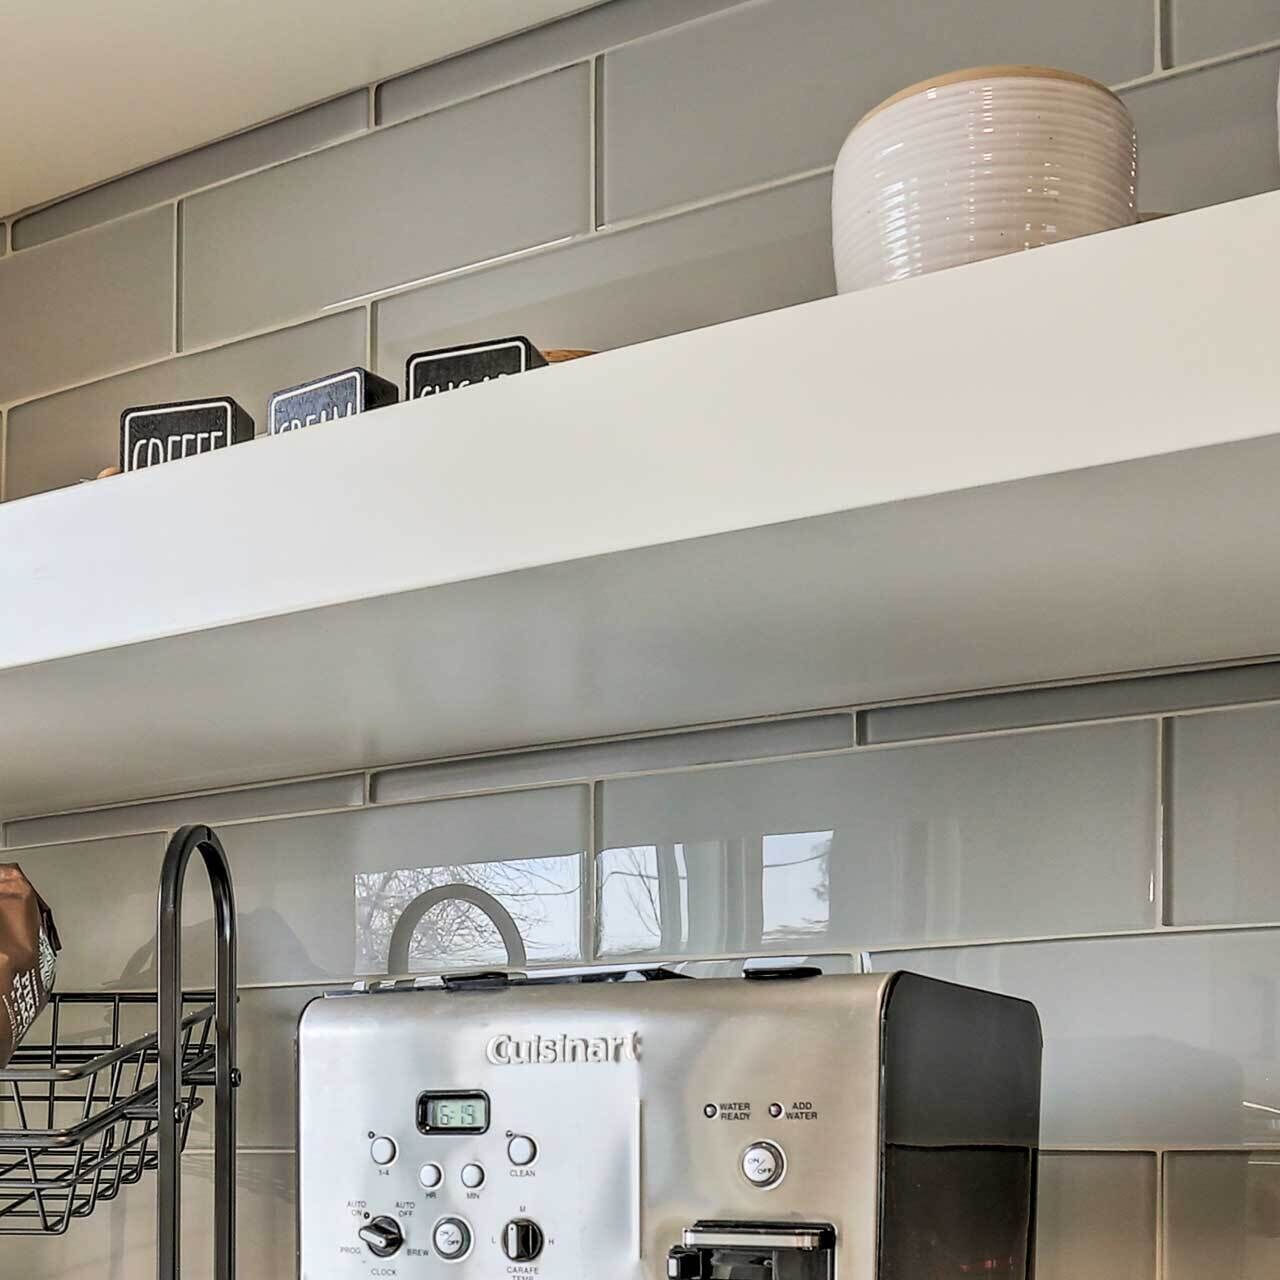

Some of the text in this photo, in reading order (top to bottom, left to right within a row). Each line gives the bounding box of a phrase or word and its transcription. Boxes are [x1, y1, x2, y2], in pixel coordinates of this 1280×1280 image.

[486, 1032, 644, 1065] Cuisinart
[720, 1103, 751, 1111] WATER
[792, 1102, 813, 1110] ADD
[786, 1112, 818, 1120] WATER
[347, 1201, 367, 1209] AUTO
[370, 1268, 397, 1276] CLOCK
[506, 1267, 539, 1275] CARAFE
